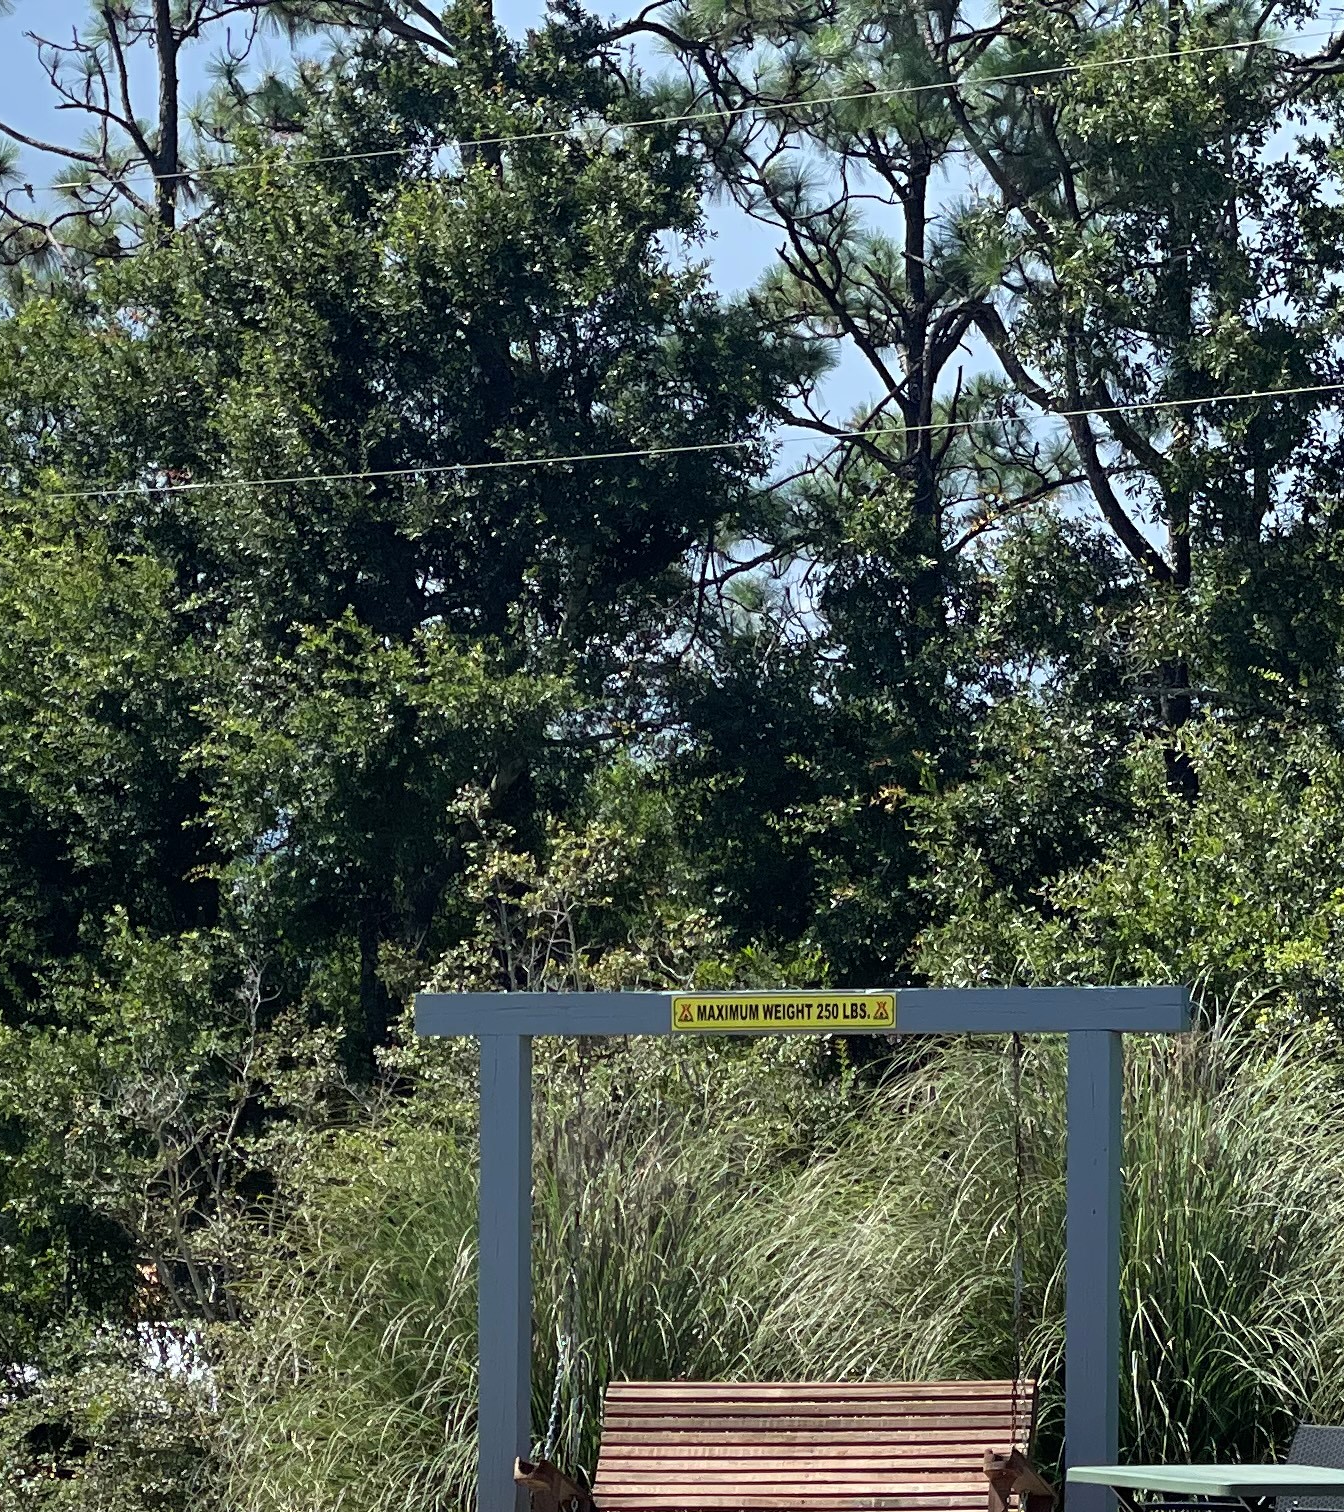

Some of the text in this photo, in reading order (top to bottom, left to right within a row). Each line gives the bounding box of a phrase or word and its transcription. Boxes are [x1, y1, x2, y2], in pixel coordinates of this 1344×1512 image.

[697, 1002, 871, 1021] MAXIMUM WEIGHT 250 LBS.
